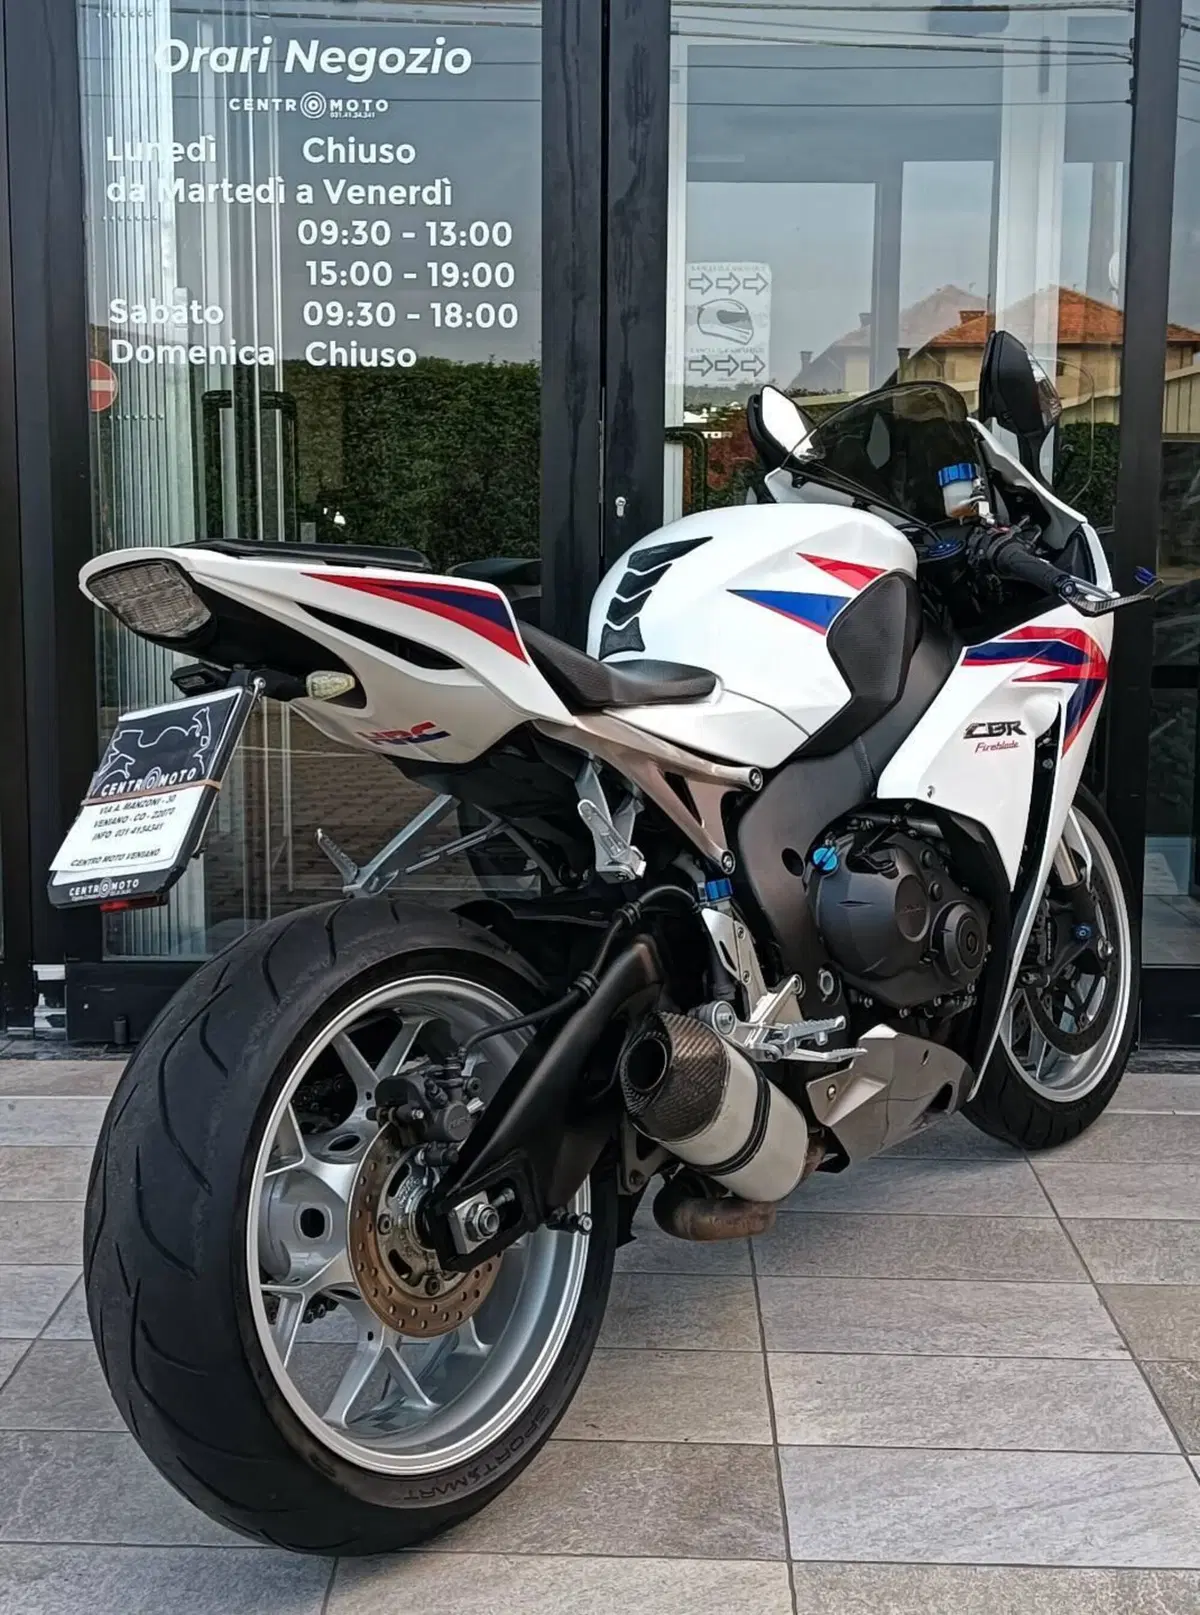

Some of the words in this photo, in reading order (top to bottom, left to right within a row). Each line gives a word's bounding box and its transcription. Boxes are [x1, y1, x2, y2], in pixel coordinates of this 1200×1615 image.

[155, 36, 272, 74] Orari
[284, 36, 472, 82] Negozio
[329, 99, 388, 112] MOTO
[106, 136, 216, 162] Lunedì
[302, 137, 415, 164] Chiuso
[107, 176, 143, 202] da
[157, 177, 286, 204] Martedì
[296, 184, 313, 205] a
[323, 178, 452, 206] Venerdì
[298, 219, 391, 246] 09:30
[425, 221, 513, 247] 13:00
[306, 261, 392, 287] 15:00
[427, 262, 515, 288] 19:00
[109, 298, 224, 324] Sabato
[303, 301, 396, 327] 09:30
[430, 303, 518, 328] 18:00
[111, 339, 275, 365] Domenica
[305, 342, 417, 368] Chiuso
[963, 720, 1027, 739] CBR
[974, 740, 1019, 753] Fireblade
[158, 767, 197, 788] MOTO
[70, 856, 103, 867] CENTRO
[102, 853, 126, 863] MOTO
[111, 878, 140, 891] MOTO
